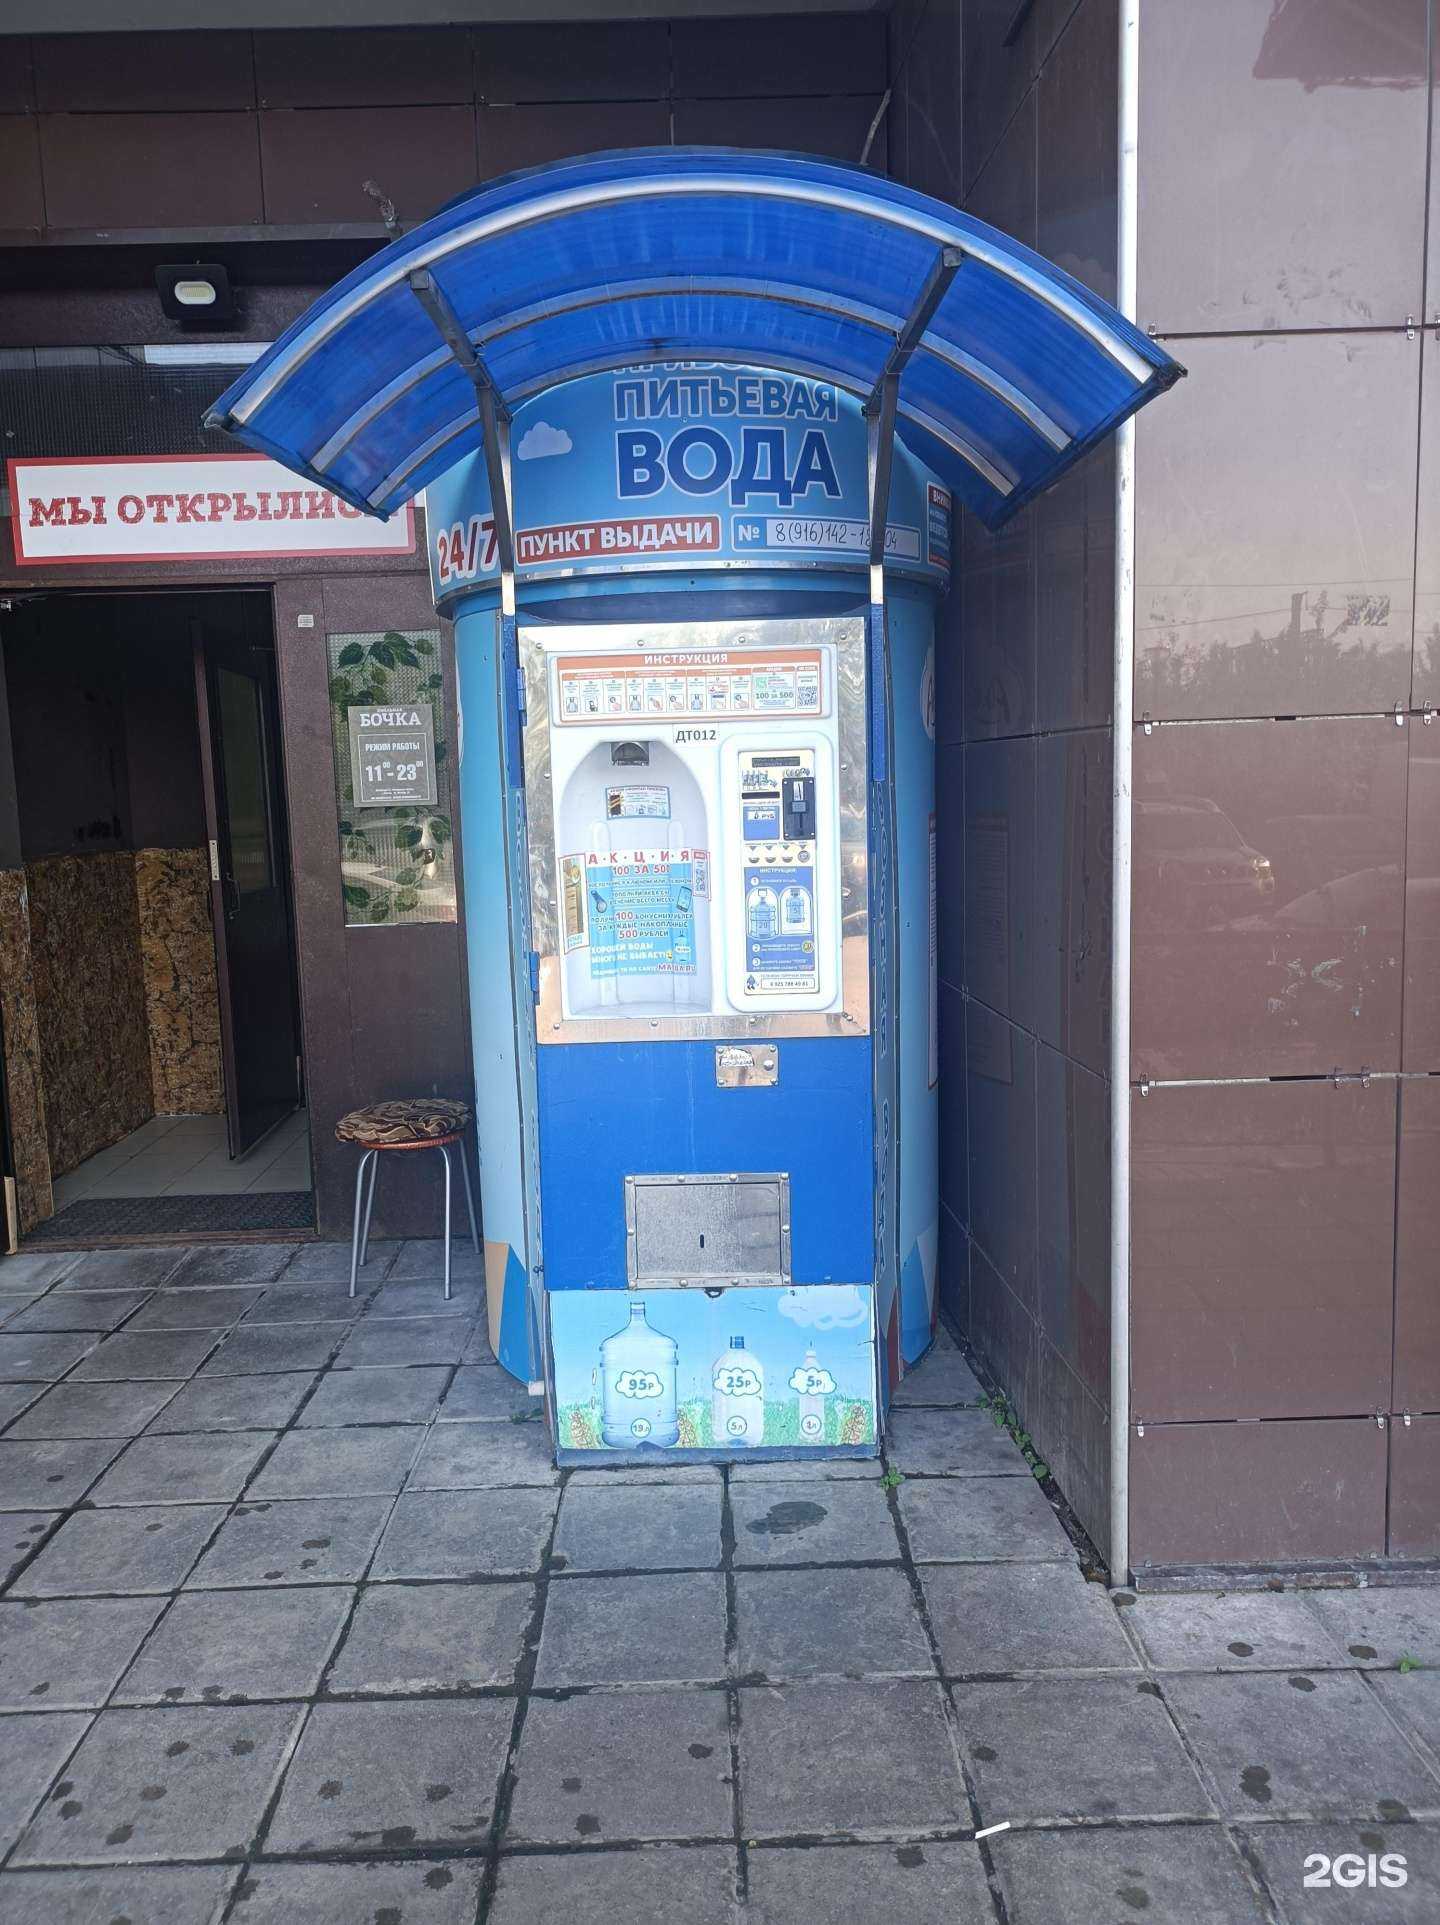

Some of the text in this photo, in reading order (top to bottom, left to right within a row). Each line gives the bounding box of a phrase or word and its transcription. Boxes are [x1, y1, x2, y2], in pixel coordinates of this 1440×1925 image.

[614, 376, 838, 421] ПИТЬЕВАЯ
[616, 426, 843, 507] ВОДА
[29, 491, 399, 527] МЫ ОТКРЫЛИС
[520, 521, 713, 557] ПУНКТ ВЫДАЧИ
[738, 524, 760, 541] №
[438, 518, 498, 580] 24/7
[644, 653, 728, 665] ИНСТРУКЦИЯ
[360, 712, 422, 727] БОЧКА
[676, 729, 717, 743] ДТ012
[392, 742, 420, 751] РАБОТЫ
[619, 929, 637, 939] 500
